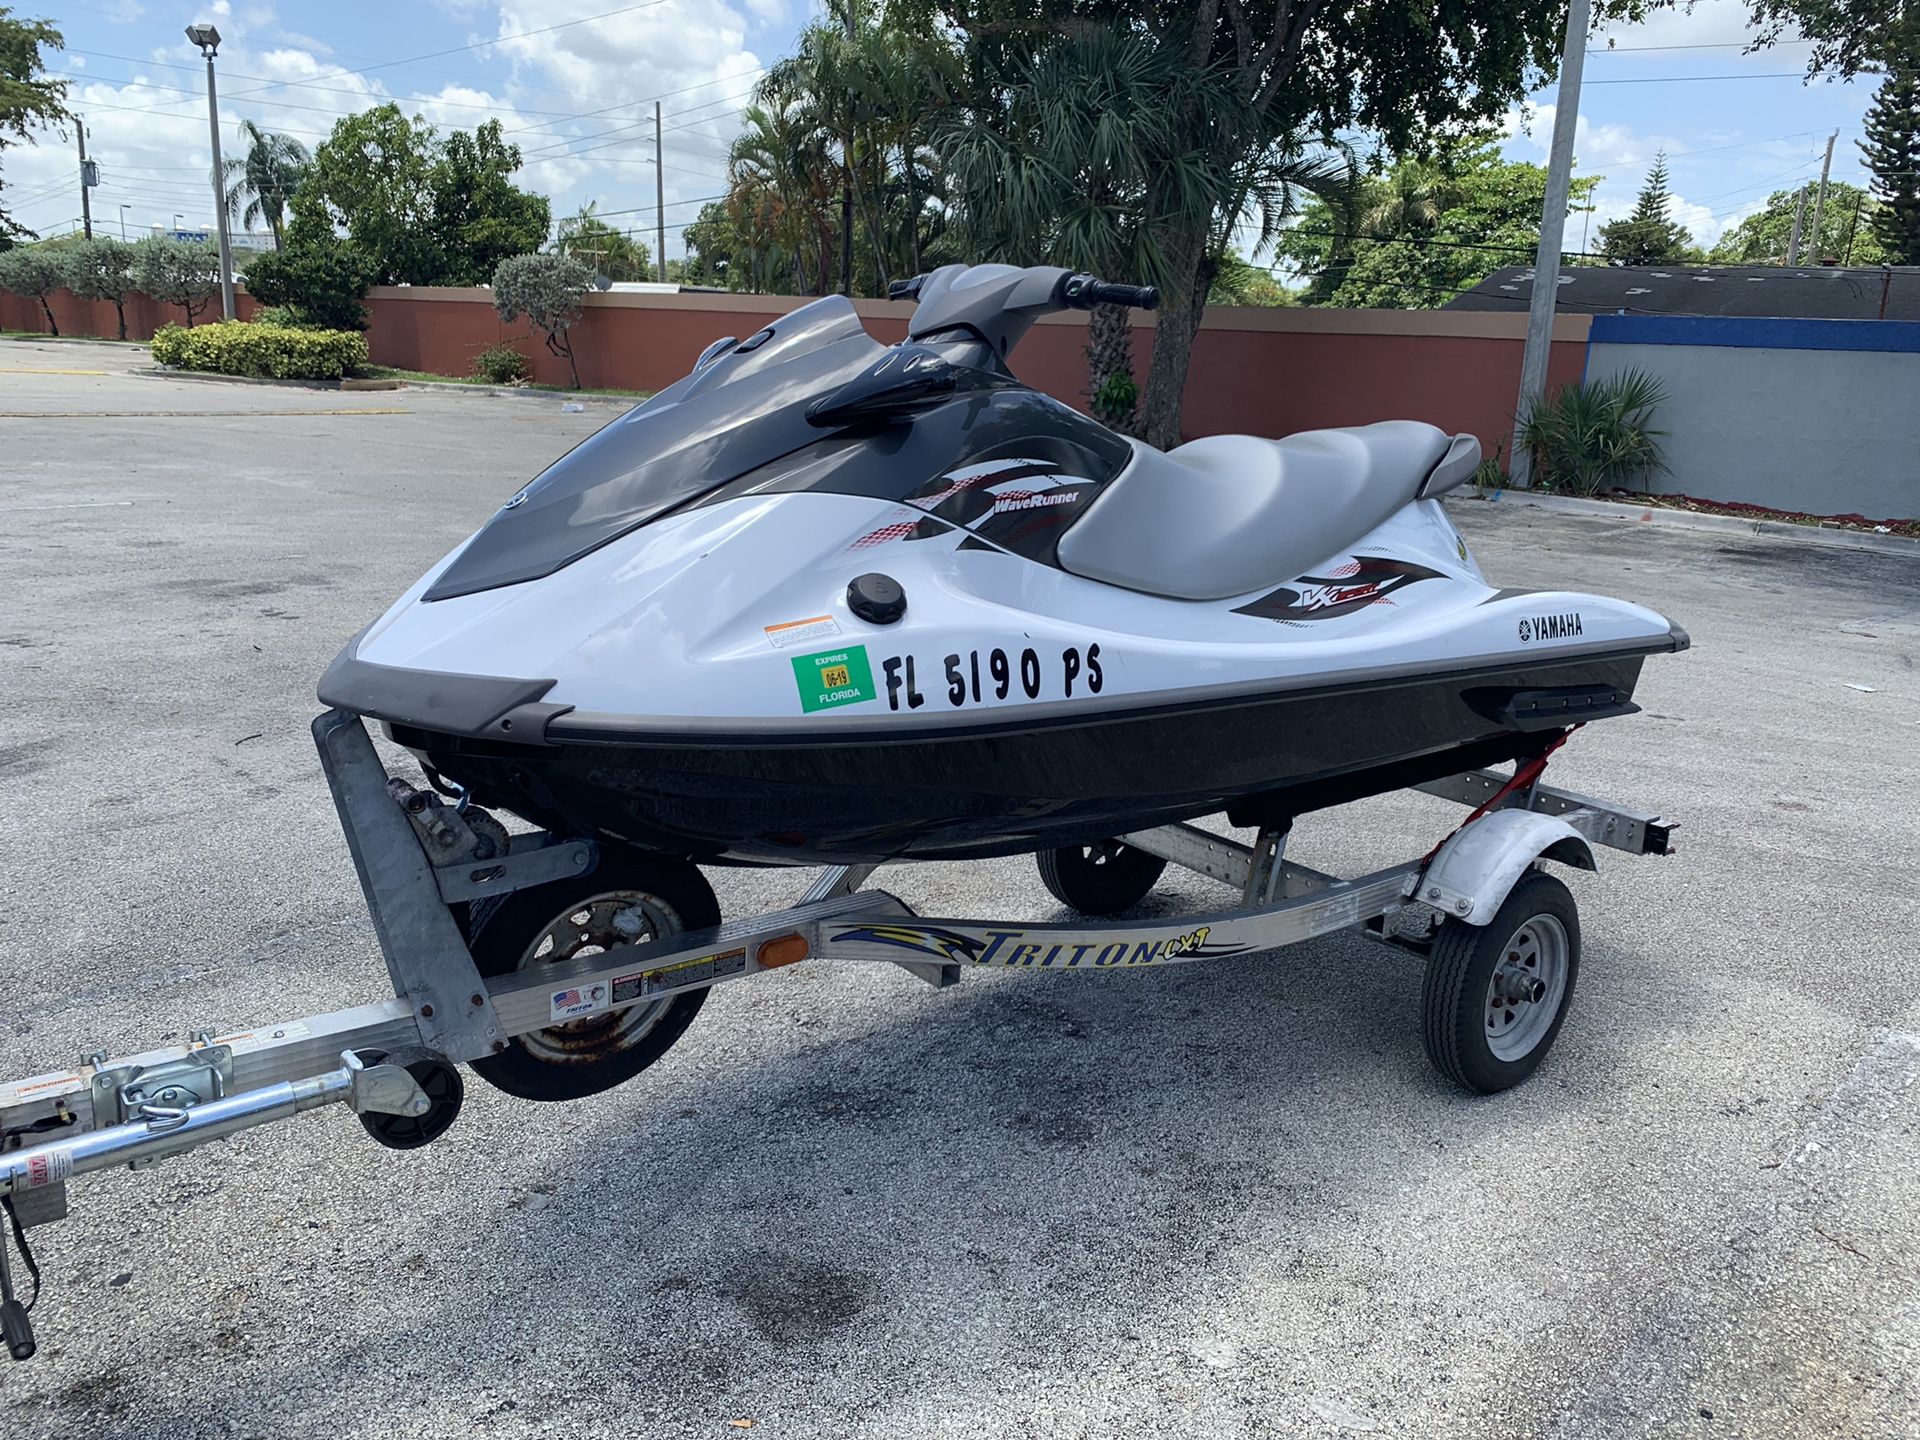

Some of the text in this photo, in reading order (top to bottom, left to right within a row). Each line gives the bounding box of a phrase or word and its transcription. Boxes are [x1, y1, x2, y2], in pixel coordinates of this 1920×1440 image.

[994, 491, 1079, 514] WaveRunner
[1533, 613, 1583, 641] YAMAHA
[815, 653, 849, 665] EXPIRES
[882, 643, 1103, 711] FL 5190 PS
[819, 688, 861, 704] FLORIDA
[974, 930, 1167, 968] TRITON
[566, 1003, 593, 1014] TRITON
